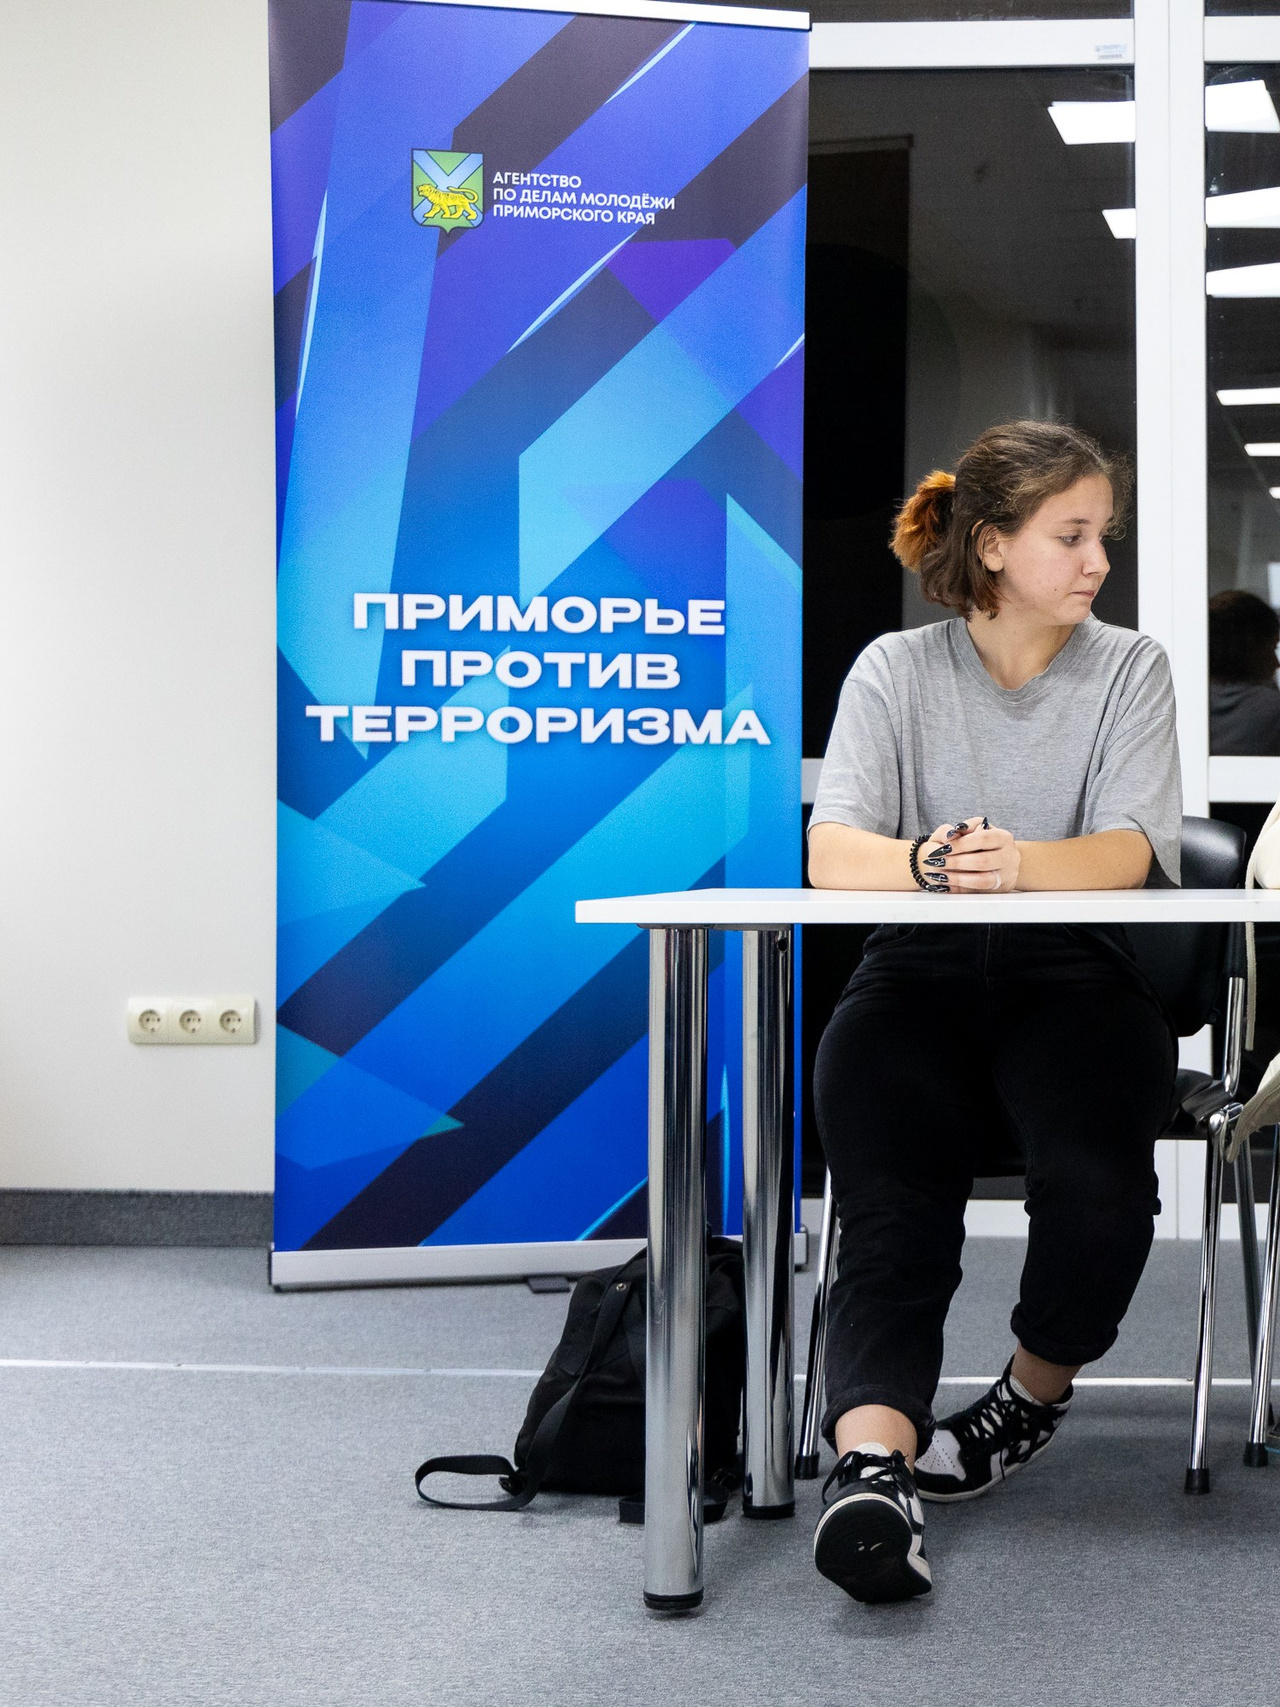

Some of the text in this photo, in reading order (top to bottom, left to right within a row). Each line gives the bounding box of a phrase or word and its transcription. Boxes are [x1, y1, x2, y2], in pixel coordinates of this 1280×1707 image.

[493, 171, 582, 188] АГЕНТСТВО
[493, 188, 676, 210] ПО ДЕЛАМ МОЛОДЁЖИ
[493, 205, 656, 225] ПРИМОРСКОГО КРАЯ
[353, 593, 726, 636] ПРИМОРЬЕ
[401, 650, 682, 690] ПРОТИВ
[305, 705, 772, 746] ТЕРРОРИЗМА
